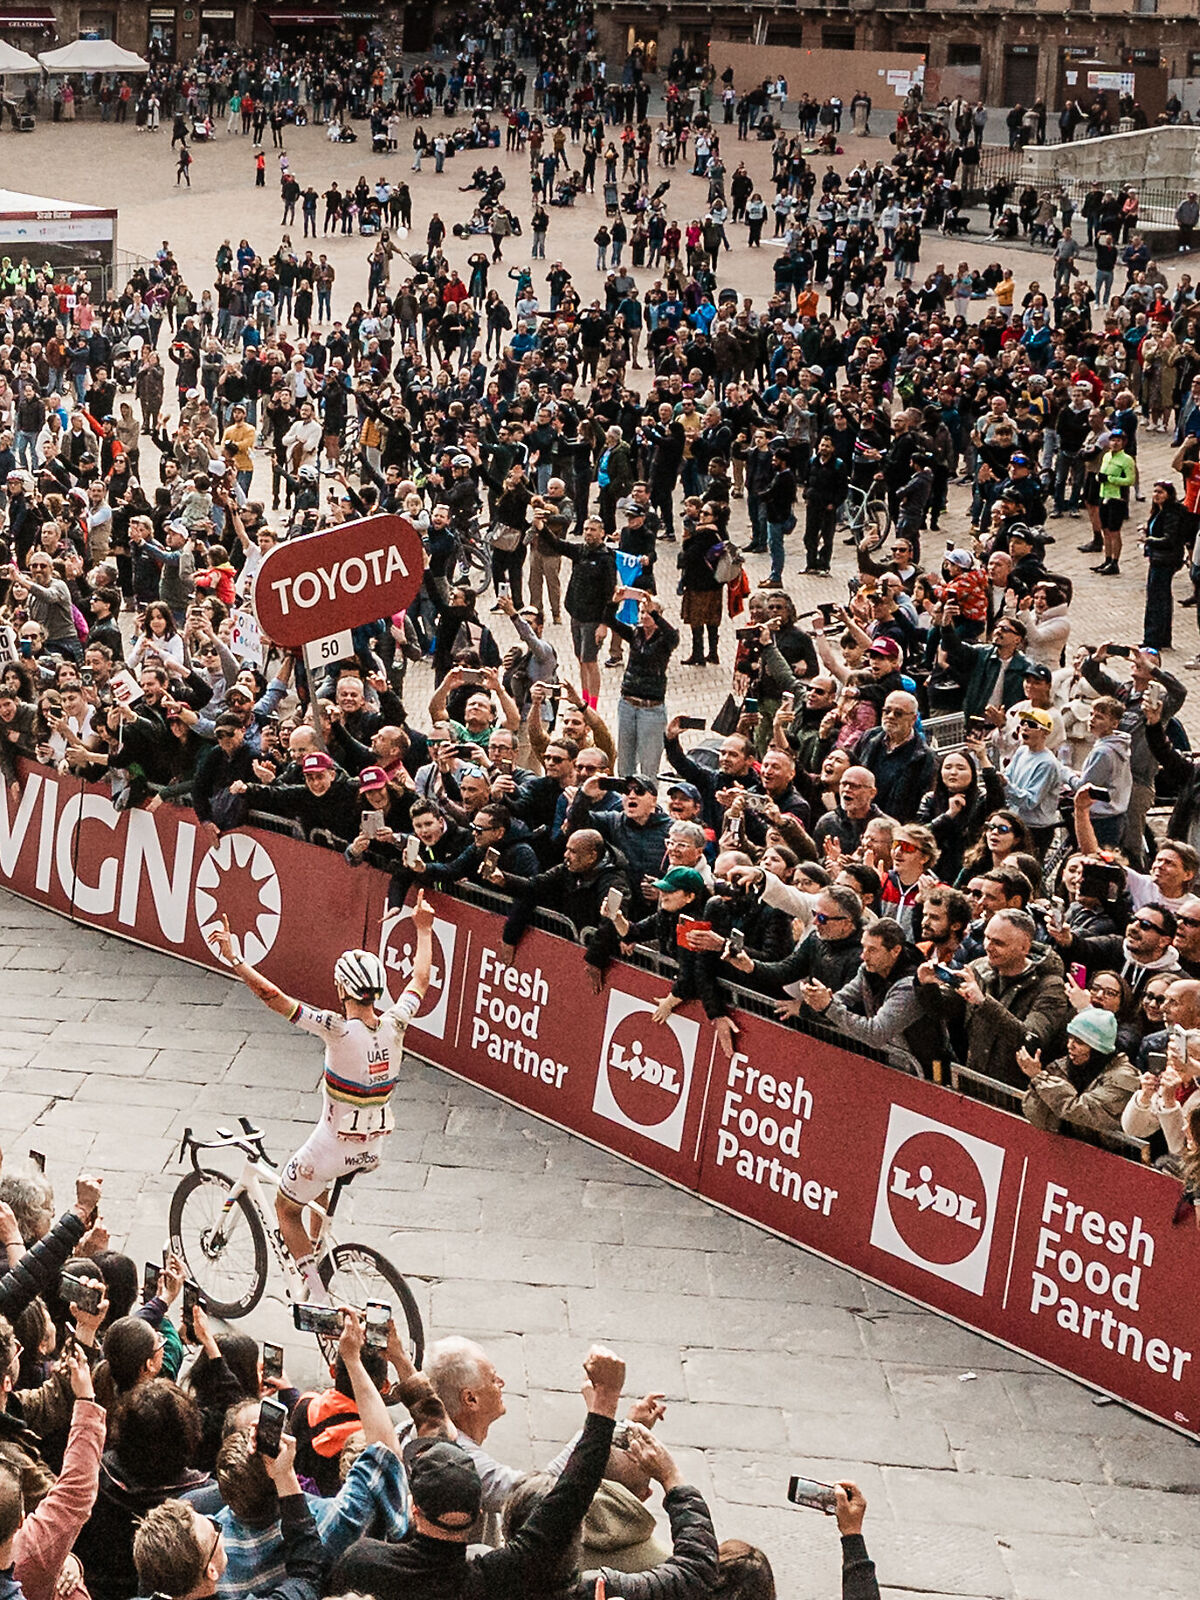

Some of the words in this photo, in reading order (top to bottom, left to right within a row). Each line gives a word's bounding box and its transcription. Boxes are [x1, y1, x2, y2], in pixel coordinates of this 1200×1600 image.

[271, 545, 409, 615] TOYOTA
[321, 639, 340, 658] 50
[479, 947, 549, 1006] Fresh
[475, 986, 540, 1041] Food
[367, 1048, 389, 1063] UAE
[471, 1018, 569, 1090] Partner
[728, 1053, 814, 1120] Fresh
[350, 1109, 359, 1130] 1
[379, 1107, 385, 1130] 1
[721, 1090, 803, 1159] Food
[716, 1129, 839, 1217] Partner
[1041, 1181, 1156, 1268] Fresh
[1036, 1226, 1142, 1312] Food
[1030, 1271, 1192, 1382] Partner
